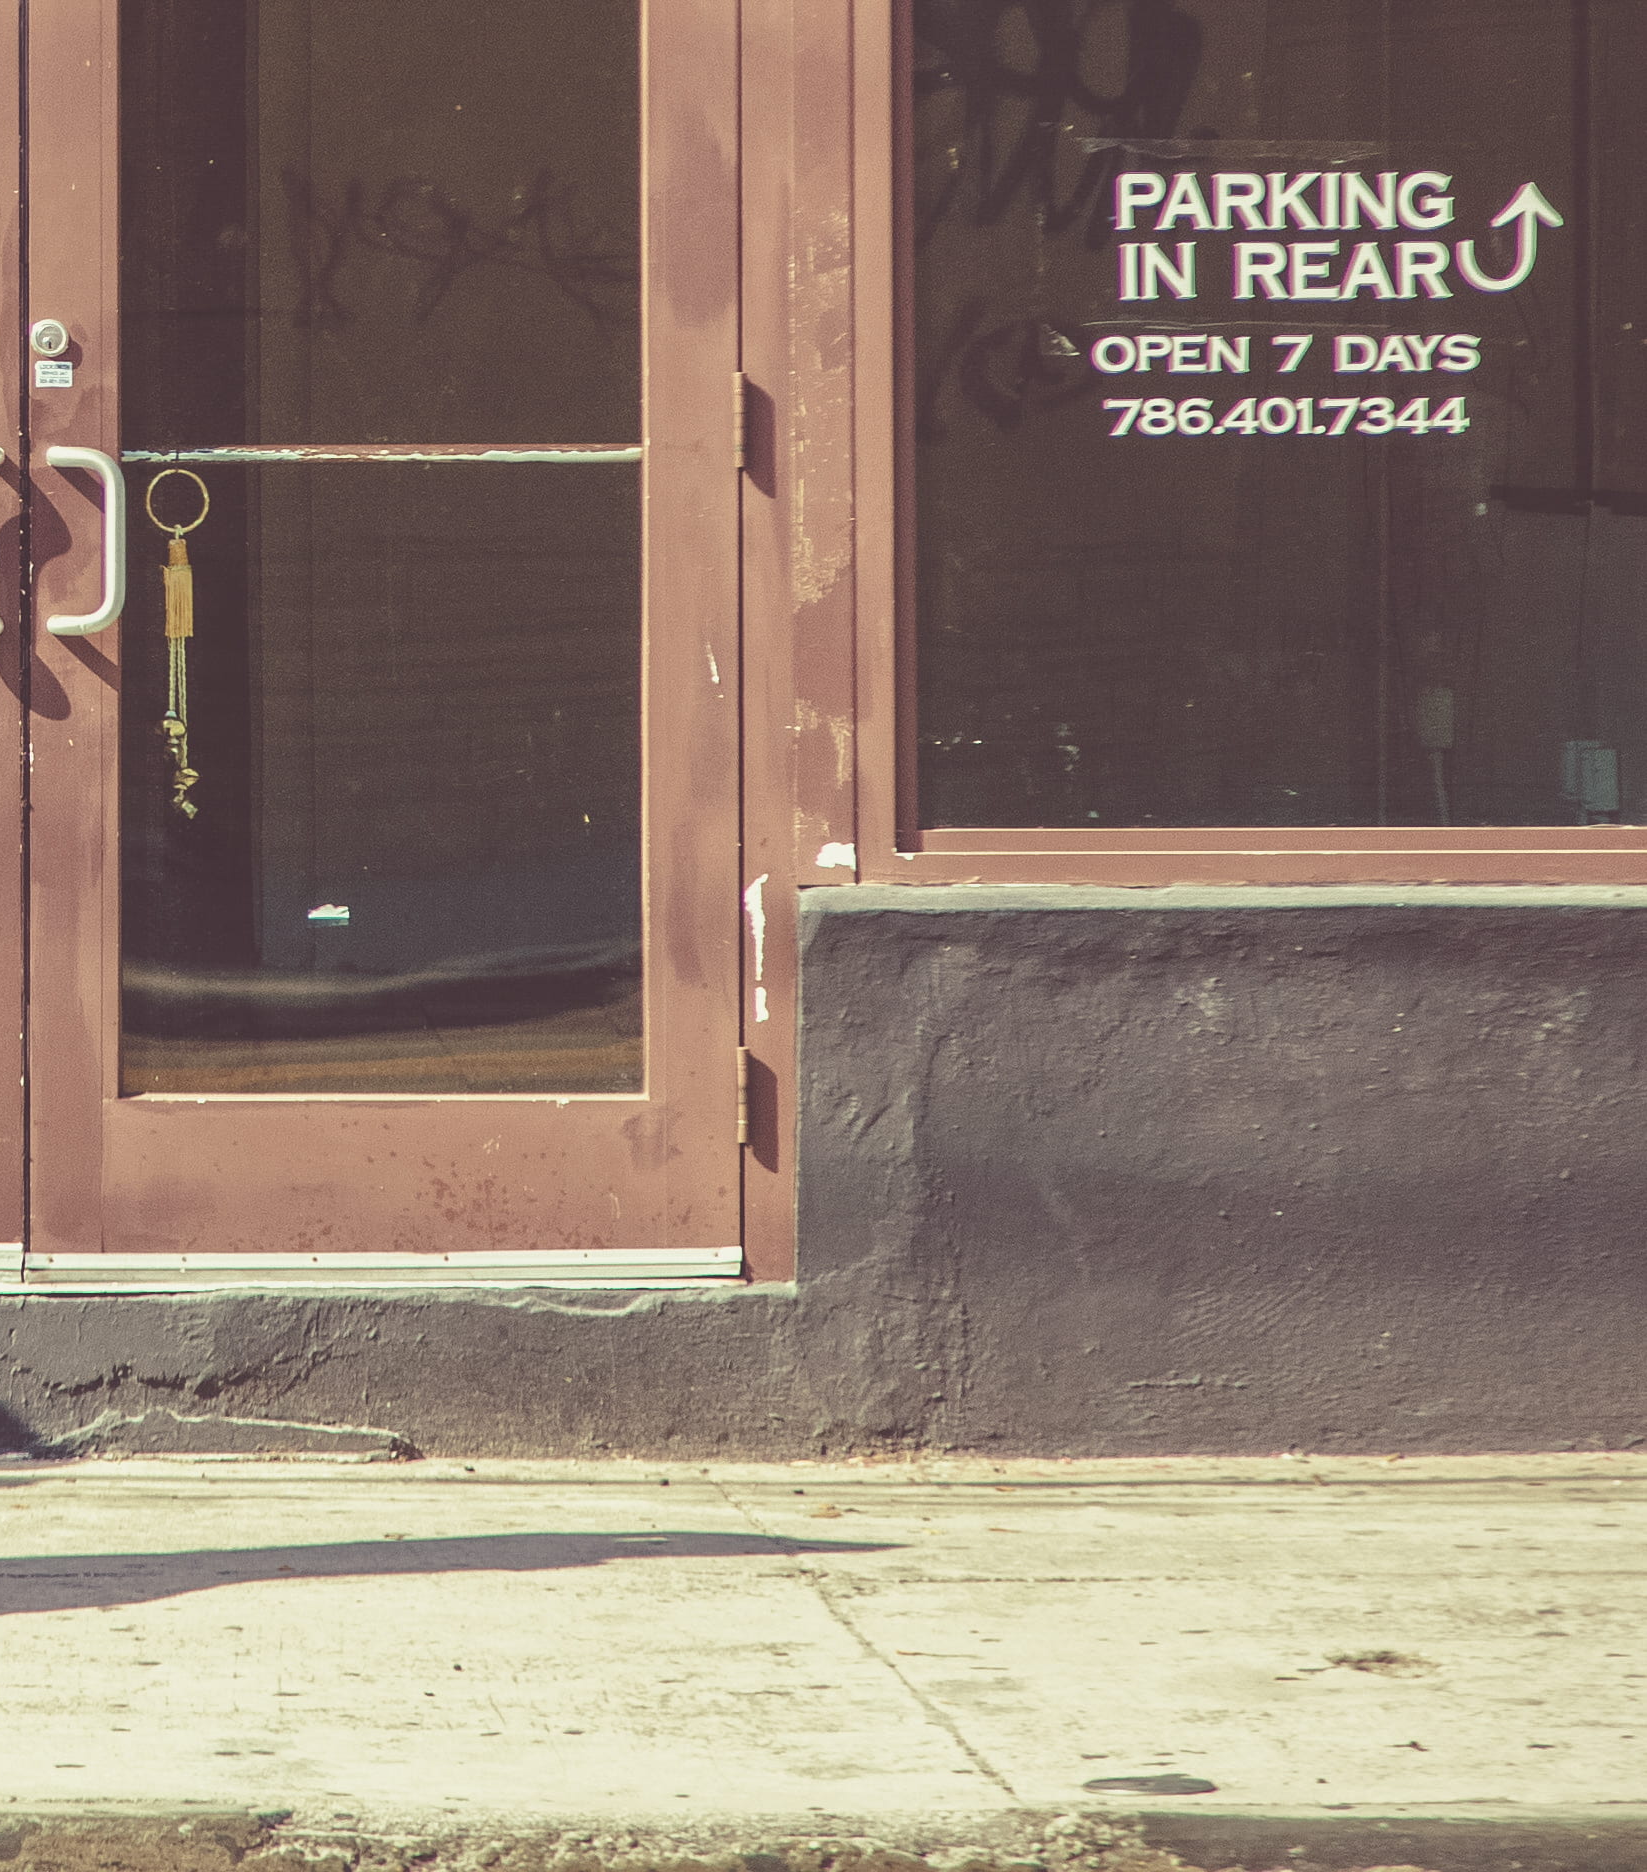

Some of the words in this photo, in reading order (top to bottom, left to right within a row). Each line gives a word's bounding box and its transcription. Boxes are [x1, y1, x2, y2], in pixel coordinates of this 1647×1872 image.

[1113, 170, 1457, 230] PARKING
[1118, 240, 1198, 301] IN
[1232, 239, 1455, 301] REAR
[1091, 333, 1251, 373] OPEN
[1271, 334, 1313, 373] 7
[1333, 333, 1482, 373] DAYS
[1103, 395, 1470, 436] 786.401.7344
